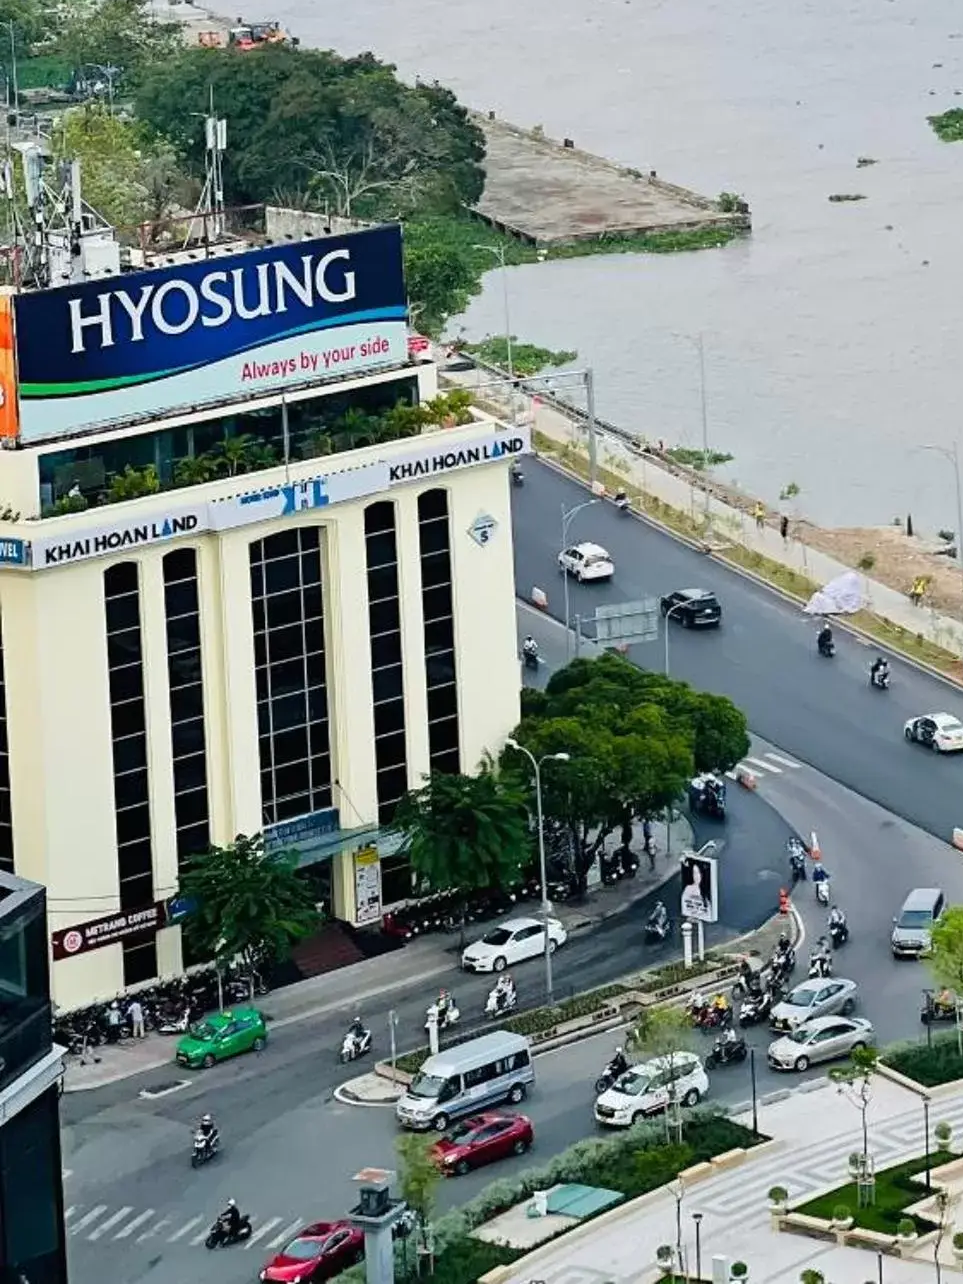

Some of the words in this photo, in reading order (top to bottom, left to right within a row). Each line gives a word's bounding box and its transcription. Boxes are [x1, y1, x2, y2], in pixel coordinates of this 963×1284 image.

[68, 249, 356, 354] HYOSUNG
[241, 357, 297, 381] Always
[300, 352, 318, 371] by
[323, 345, 356, 368] your
[360, 336, 390, 357] side
[389, 458, 429, 481] KHAI
[432, 447, 480, 471] HOAN
[483, 438, 523, 459] LAND
[45, 539, 90, 564] KHAI
[94, 525, 148, 552] HOAN
[152, 514, 198, 538] LAND
